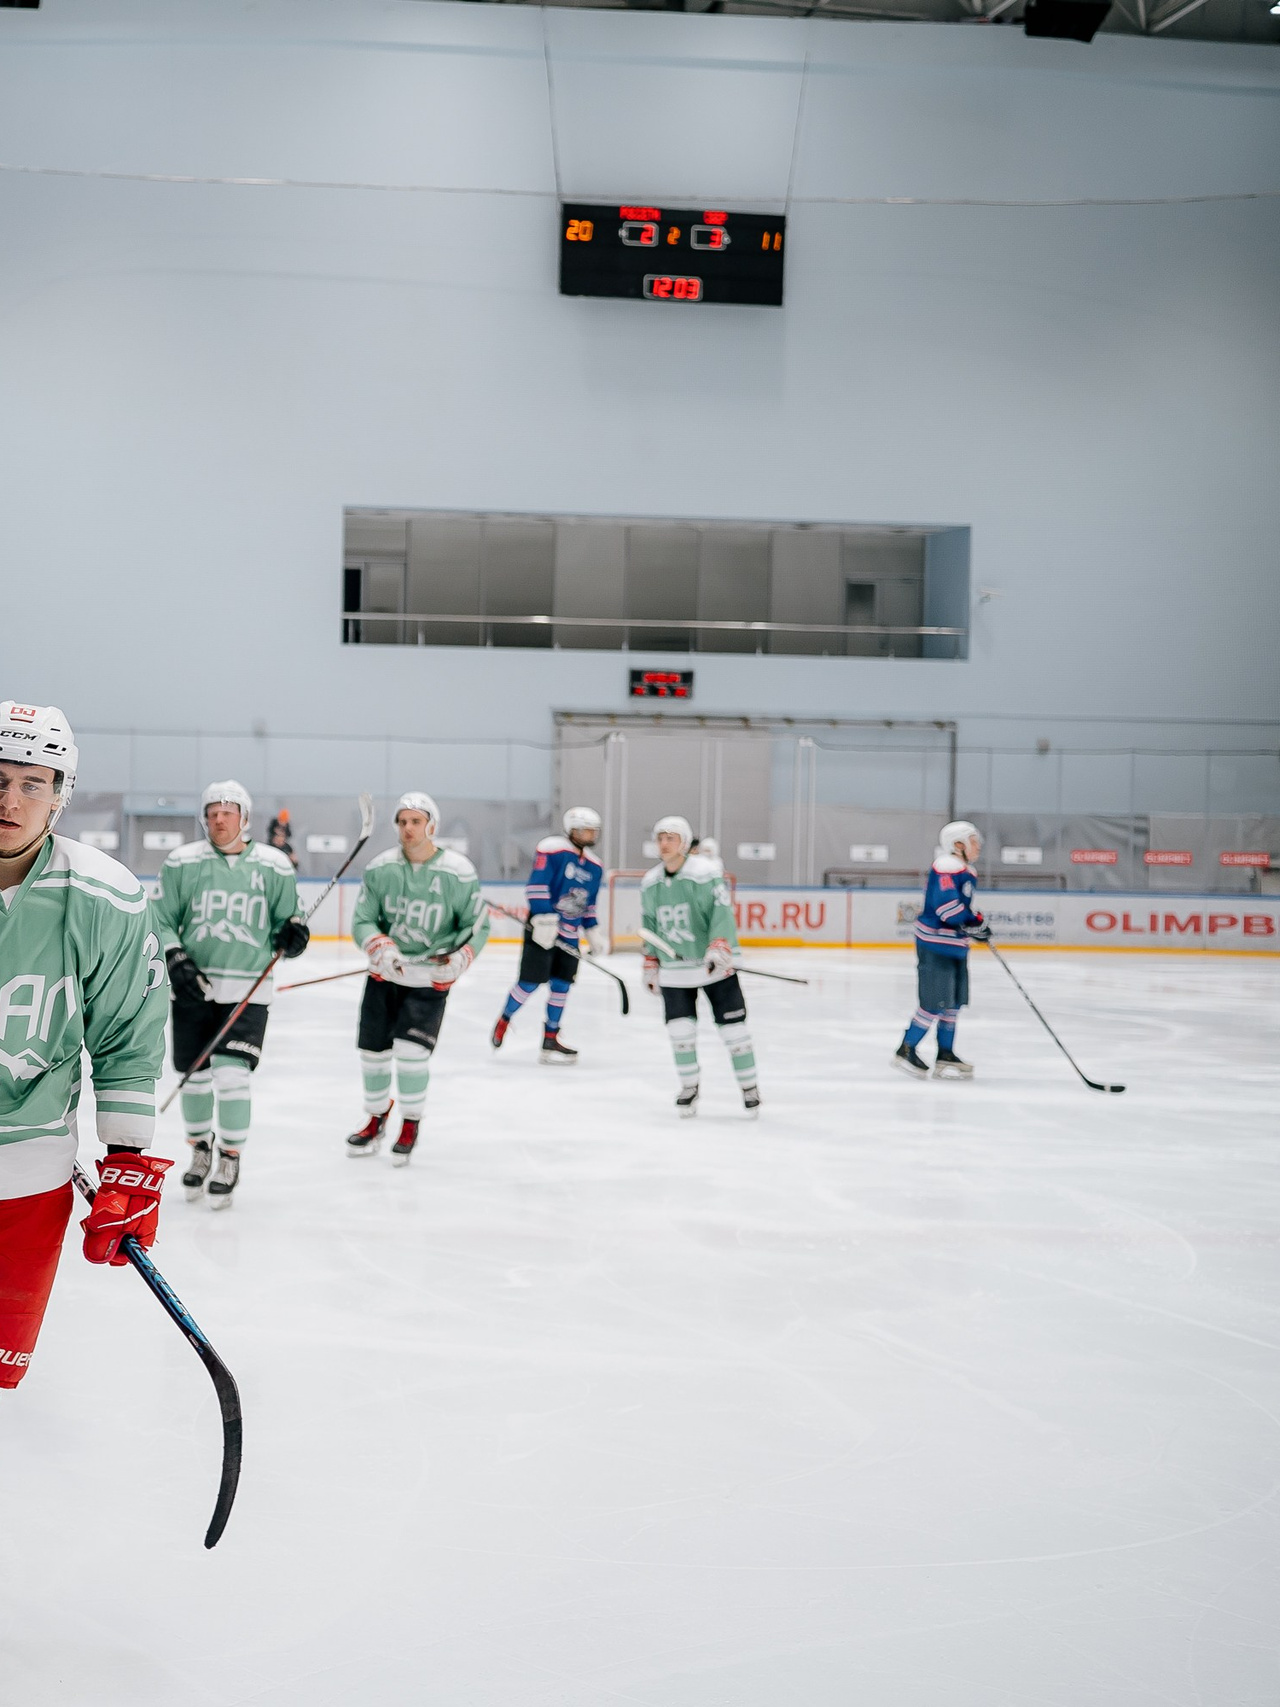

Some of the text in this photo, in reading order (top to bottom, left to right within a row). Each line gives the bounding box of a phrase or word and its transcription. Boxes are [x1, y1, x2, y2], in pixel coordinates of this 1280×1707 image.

[566, 219, 594, 241] 20
[640, 224, 655, 244] 2
[666, 226, 680, 245] 2
[709, 228, 724, 248] 3
[761, 231, 783, 251] 11
[0, 730, 38, 741] CCM
[1086, 911, 1280, 937] OLIMPB
[141, 930, 171, 999] 3
